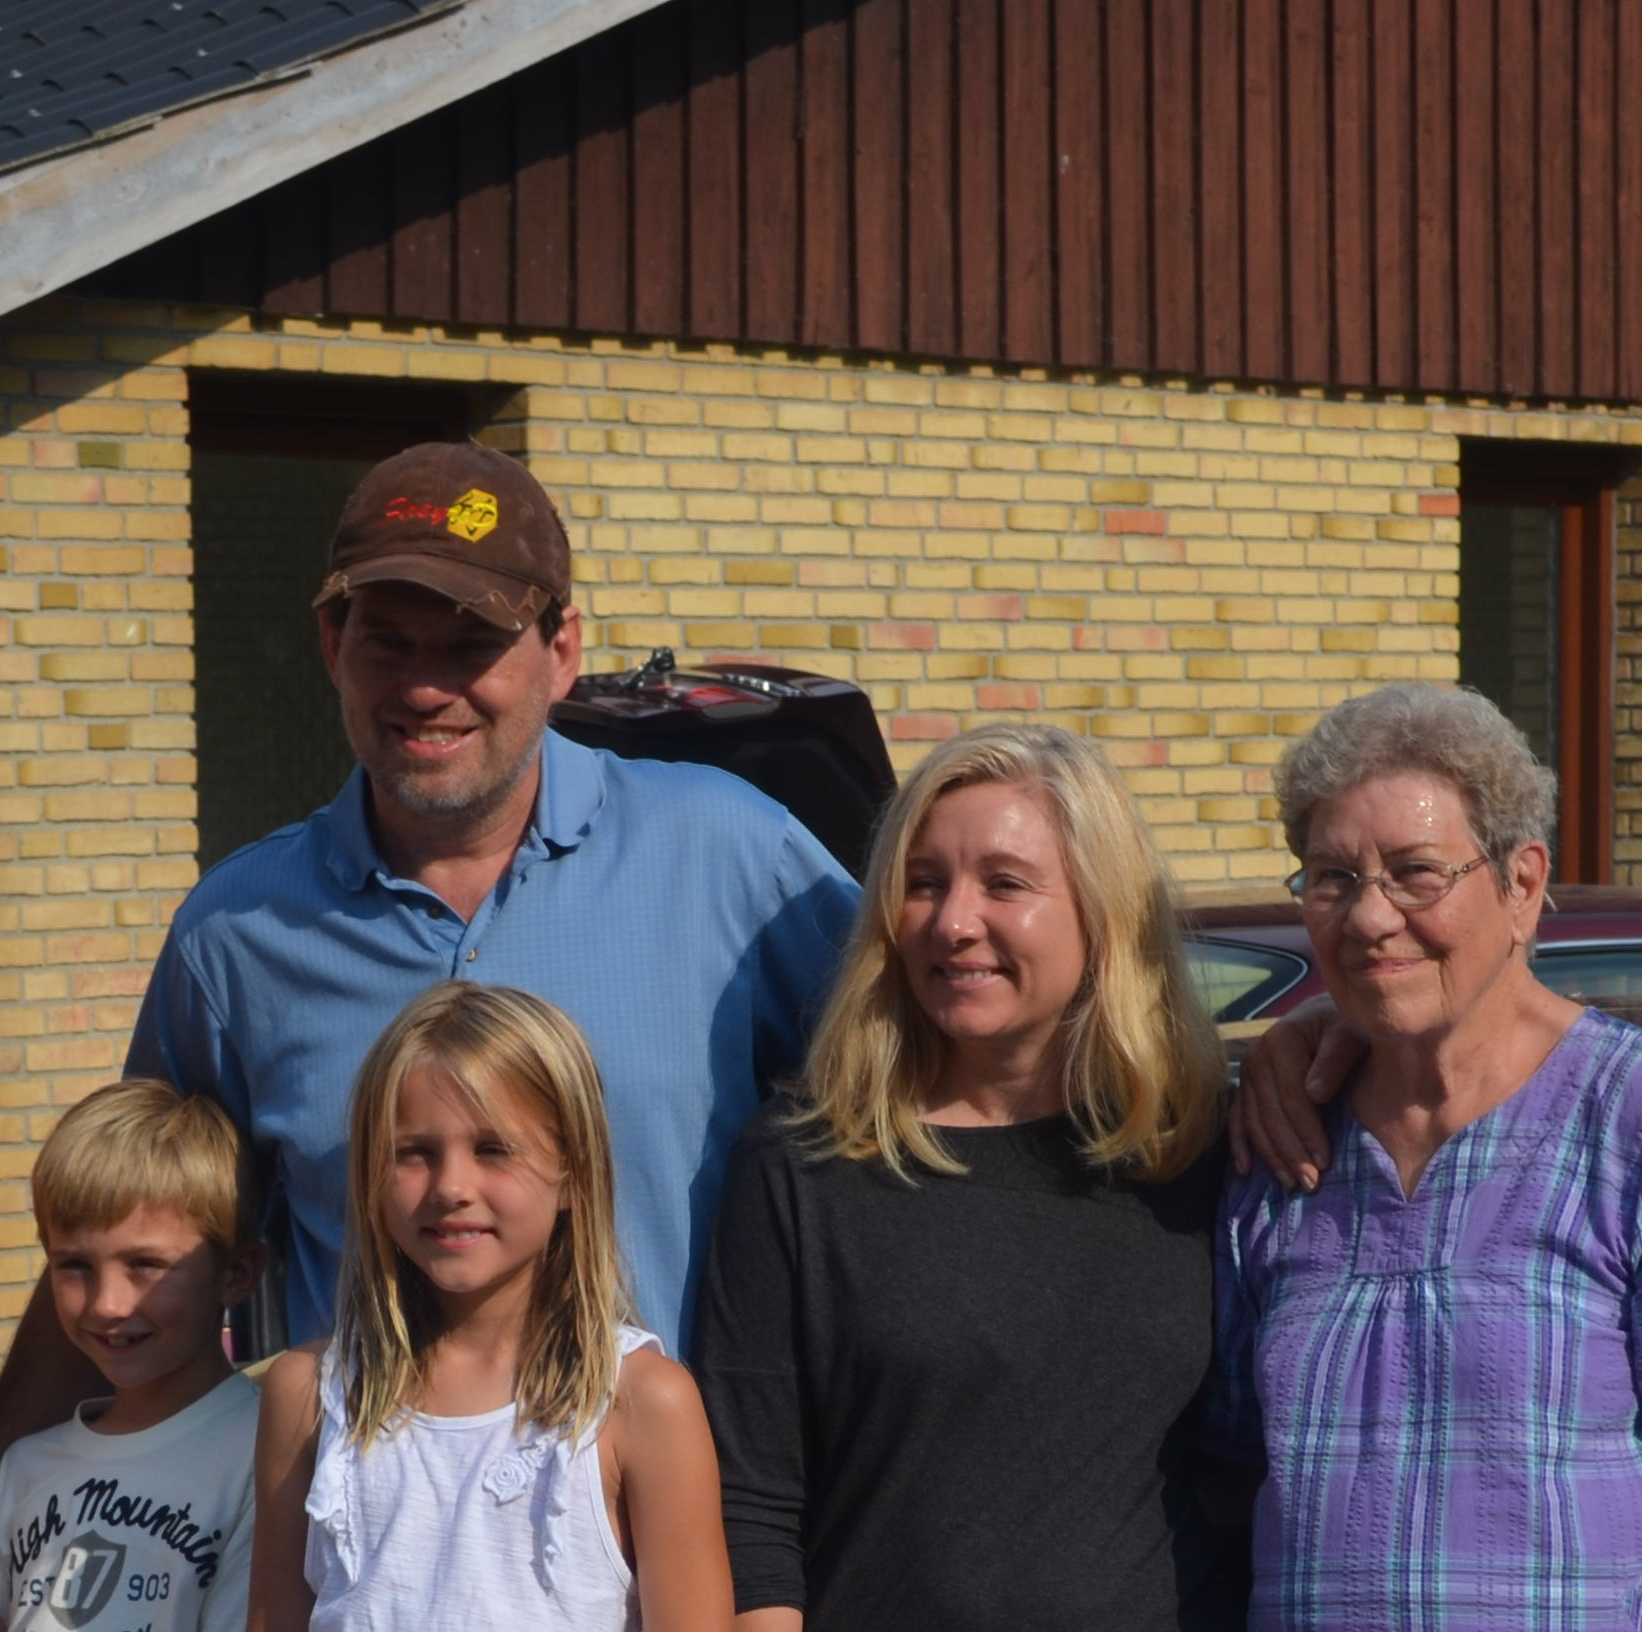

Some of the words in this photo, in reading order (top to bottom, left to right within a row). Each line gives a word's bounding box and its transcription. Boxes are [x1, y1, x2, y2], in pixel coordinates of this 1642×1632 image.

[73, 1478, 222, 1589] Mountain
[50, 1547, 118, 1609] 87
[127, 1572, 170, 1602] 903
